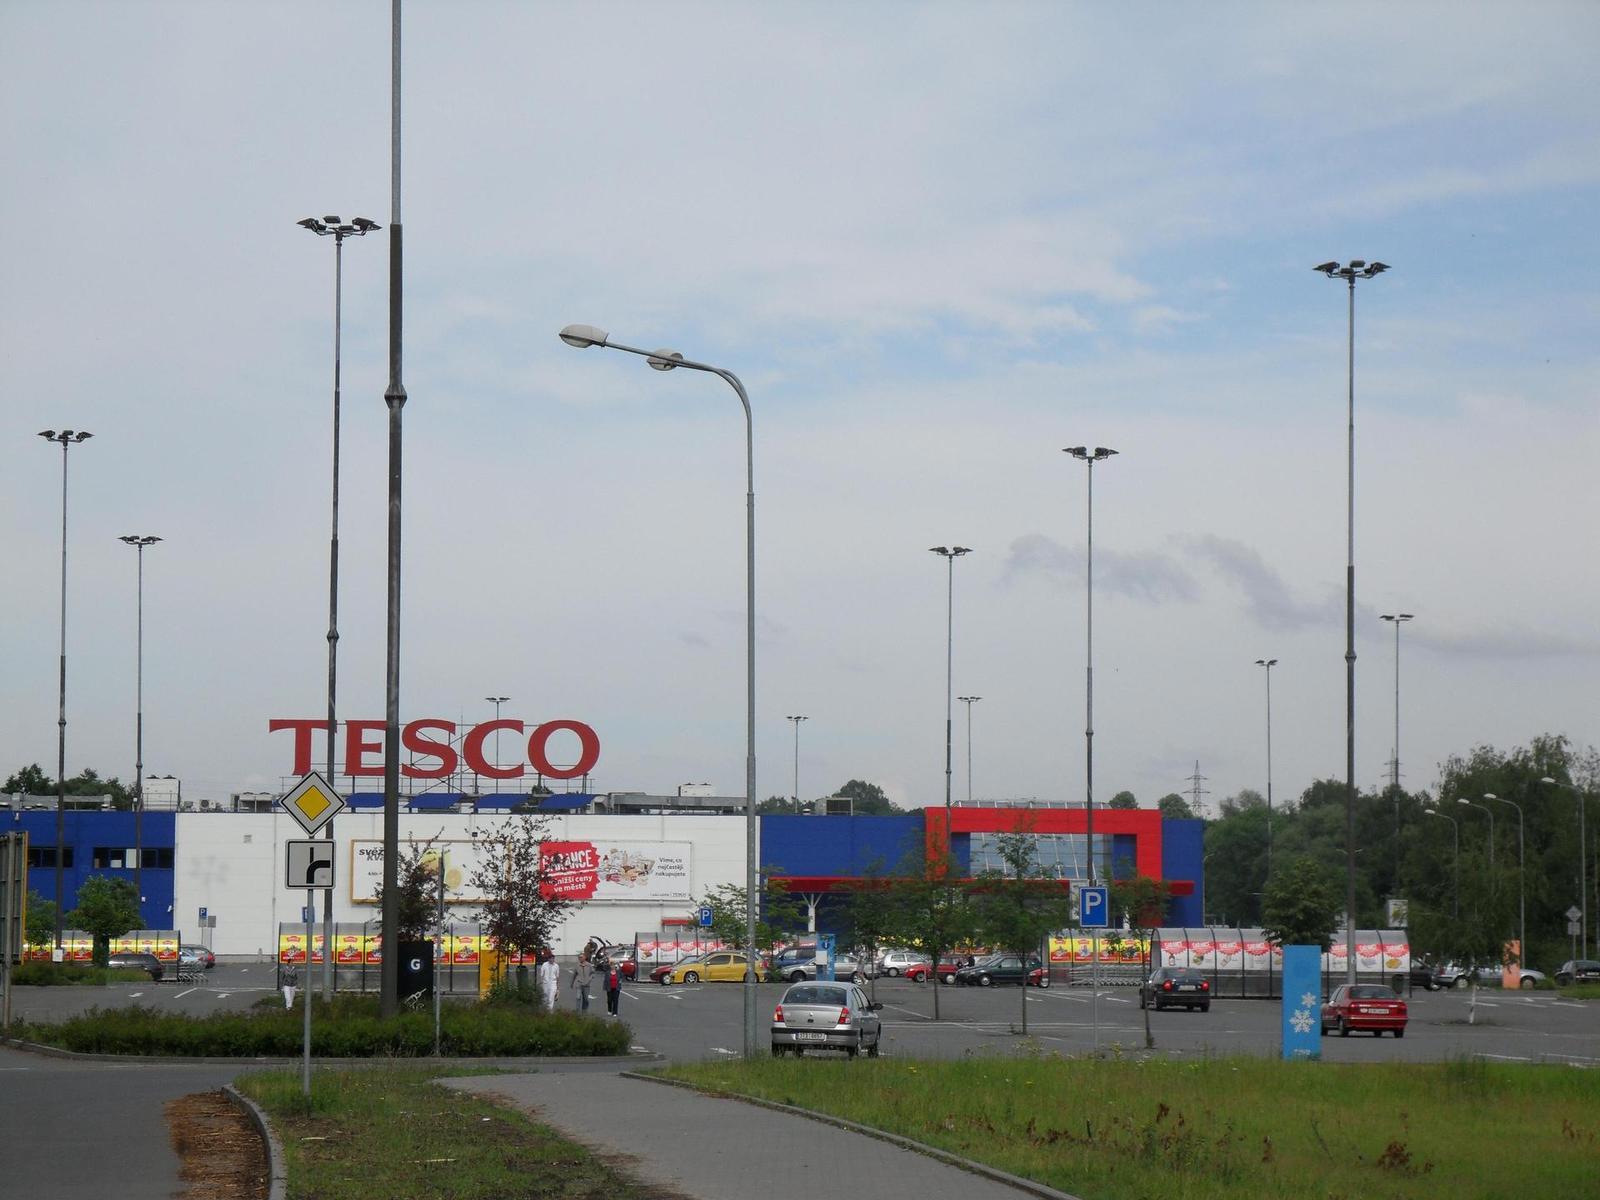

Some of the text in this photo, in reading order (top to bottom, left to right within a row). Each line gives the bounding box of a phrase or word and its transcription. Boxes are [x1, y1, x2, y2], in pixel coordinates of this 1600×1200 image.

[269, 719, 600, 779] TESCO
[359, 847, 384, 856] svěž
[542, 850, 593, 872] GRANCE
[575, 875, 593, 883] ceny
[564, 883, 586, 892] městě
[1085, 891, 1102, 915] P
[702, 909, 710, 921] P
[410, 958, 421, 970] G
